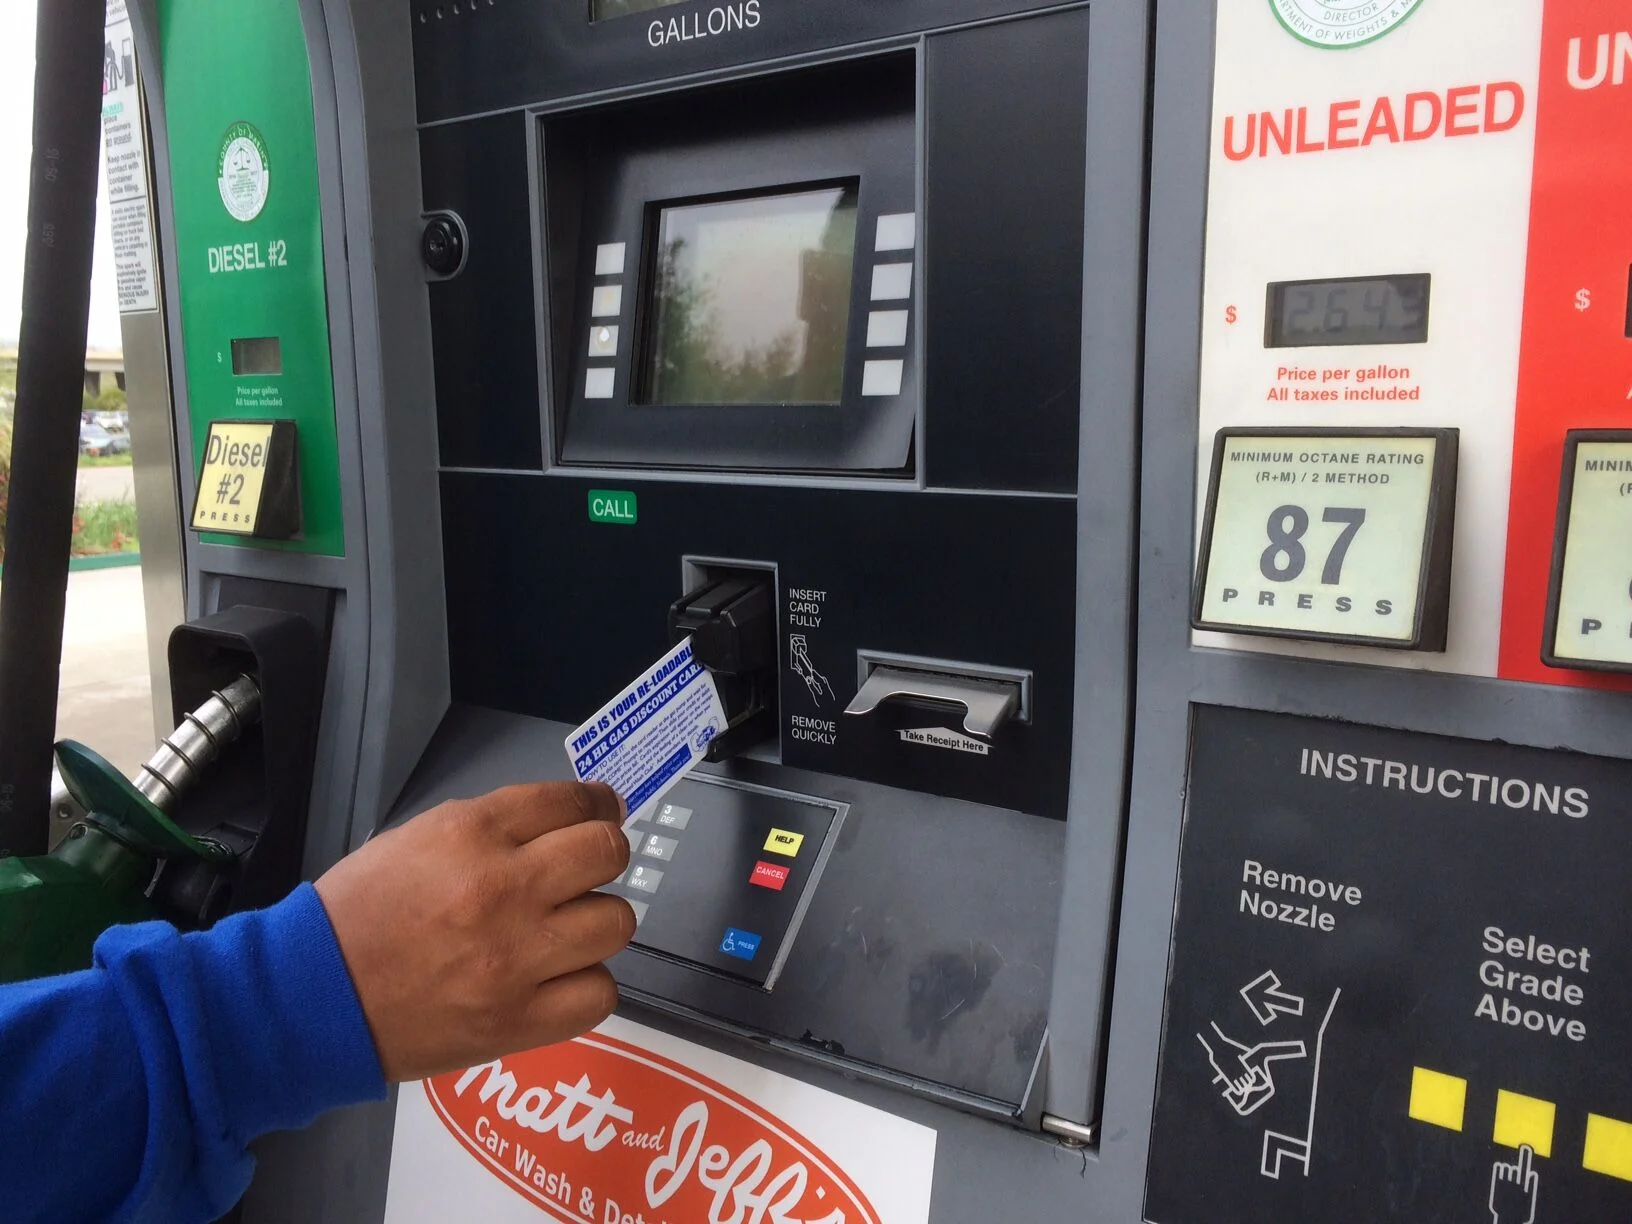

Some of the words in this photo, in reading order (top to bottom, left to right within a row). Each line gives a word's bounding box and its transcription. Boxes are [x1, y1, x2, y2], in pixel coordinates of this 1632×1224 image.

[1323, 3, 1379, 21] DIRECTOR
[648, 0, 761, 47] GALLONS
[1315, 28, 1329, 39] OF
[1334, 17, 1388, 40] WEIGHTS
[1391, 9, 1399, 18] &
[1223, 81, 1525, 161] UNLEADED
[208, 242, 265, 272] DIESEL
[268, 240, 287, 266] #2
[1574, 287, 1592, 312] $
[1225, 305, 1238, 325] $
[217, 352, 222, 363] $
[1277, 366, 1317, 382] Price
[1322, 368, 1351, 384] per
[1356, 365, 1411, 384] gallon
[1267, 387, 1290, 401] All
[1294, 389, 1338, 401] taxes
[1344, 385, 1421, 401] included
[1230, 452, 1294, 464] MINIMUM
[1299, 452, 1360, 465] OCTANE
[1366, 453, 1425, 466] RATING
[1255, 472, 1297, 485] (R+M)
[1311, 473, 1320, 484] 2
[1325, 473, 1390, 486] METHOD
[217, 473, 245, 505] #2
[200, 511, 250, 524] PRESS
[592, 498, 634, 518] CALL
[1259, 504, 1366, 586] 87
[789, 588, 827, 602] INSERT
[1221, 588, 1392, 616] PRESS
[789, 602, 819, 615] CARD
[790, 614, 822, 628] FULLY
[572, 726, 598, 753] THIS
[597, 716, 610, 732] IS
[609, 692, 637, 721] YOUR
[578, 756, 592, 773] 24
[592, 741, 609, 760] HR
[609, 722, 629, 745] GAS
[629, 680, 677, 728] DISCOUNT
[679, 664, 701, 685] CAR
[791, 715, 836, 733] REMOVE
[791, 728, 837, 745] QUICKLY
[904, 730, 924, 743] Take
[926, 734, 960, 749] Receipt
[962, 738, 984, 752] Here
[598, 760, 607, 770] TO
[1300, 747, 1590, 819] INSTRUCTIONS
[663, 804, 672, 815] 3
[660, 815, 676, 824] DEF
[650, 835, 658, 845] 6
[774, 834, 795, 845] HELP
[646, 845, 663, 856] MNO
[635, 866, 644, 877] 9
[755, 866, 785, 880] CANCEL
[1243, 860, 1362, 905] Remove
[1239, 890, 1336, 931] Nozzle
[737, 940, 755, 951] PRESS
[1482, 927, 1591, 973] Select
[1479, 961, 1585, 1006] Grade
[1474, 994, 1587, 1042] Above
[622, 1125, 666, 1152] and
[474, 1115, 510, 1158] Car
[514, 1142, 571, 1206] Wash
[580, 1187, 595, 1219] &
